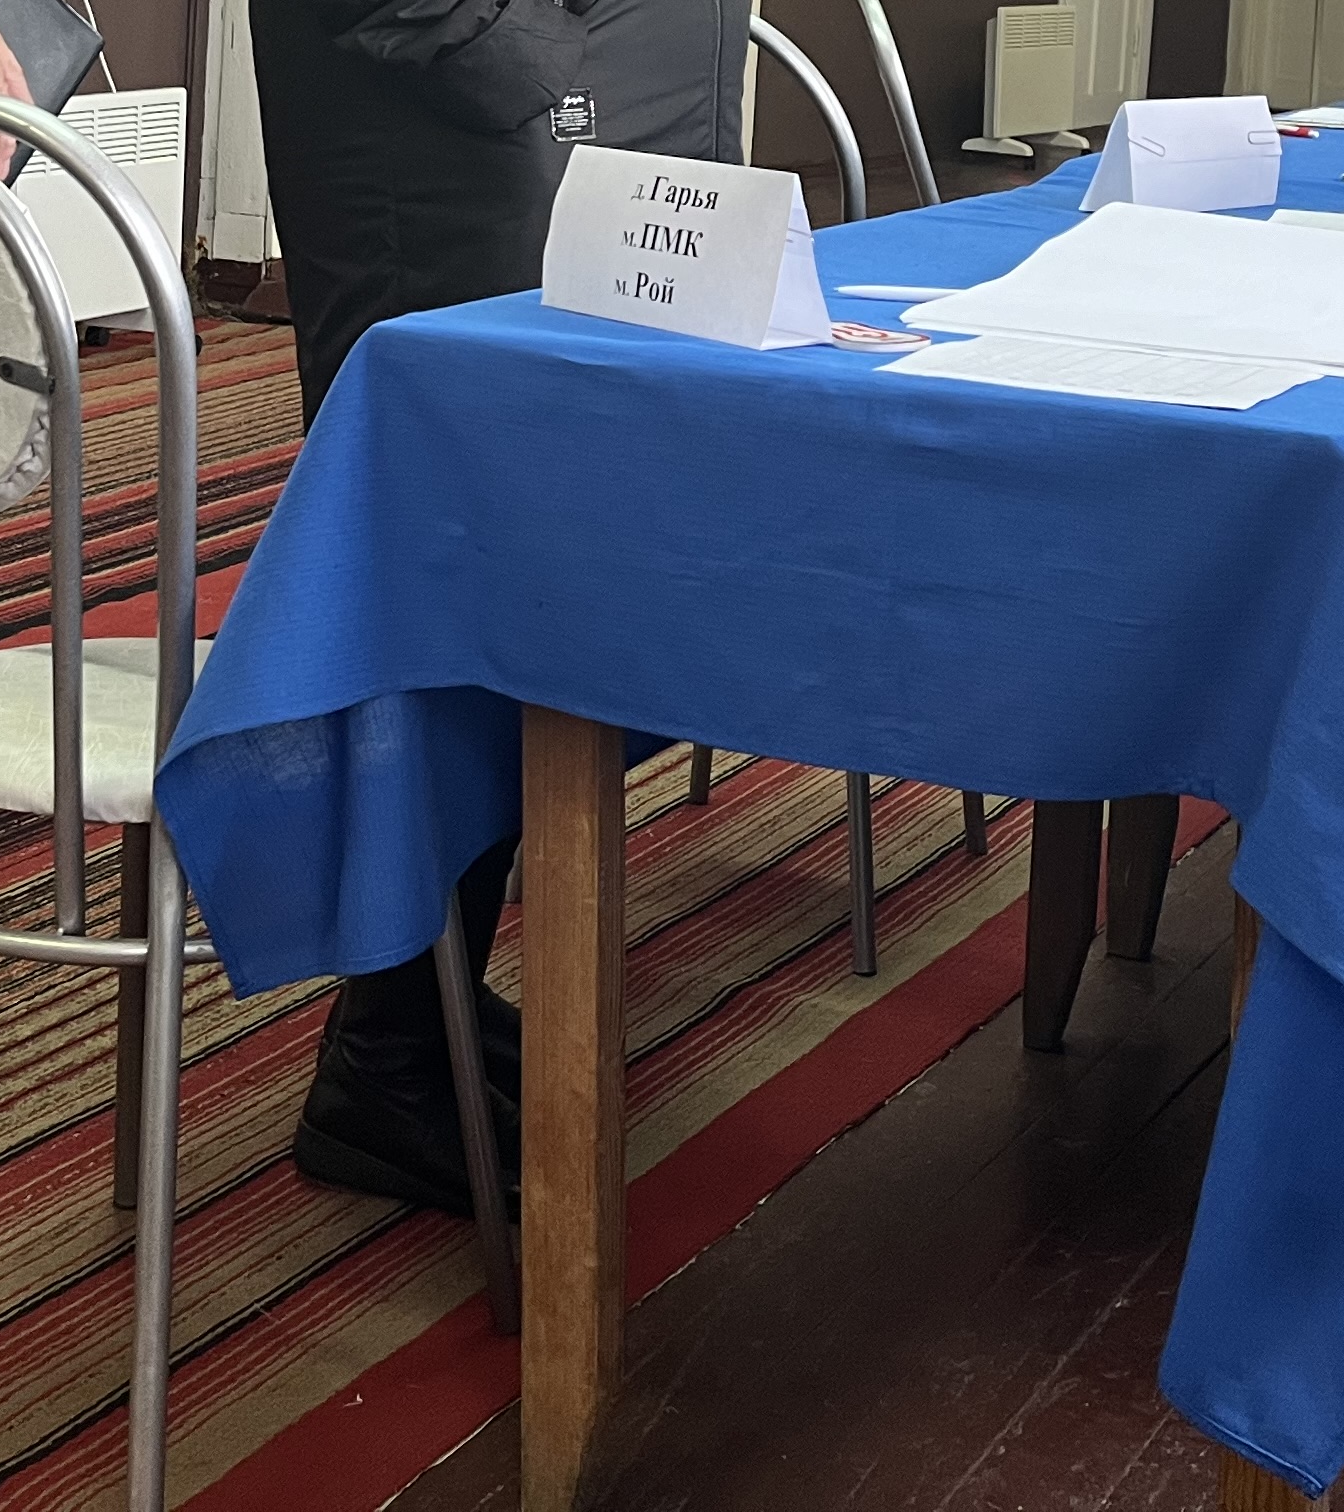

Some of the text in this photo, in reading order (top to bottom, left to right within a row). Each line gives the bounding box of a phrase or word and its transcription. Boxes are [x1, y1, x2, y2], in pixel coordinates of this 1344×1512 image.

[649, 176, 719, 213] Гарья
[639, 223, 704, 258] ПМК
[633, 272, 676, 305] Рой
